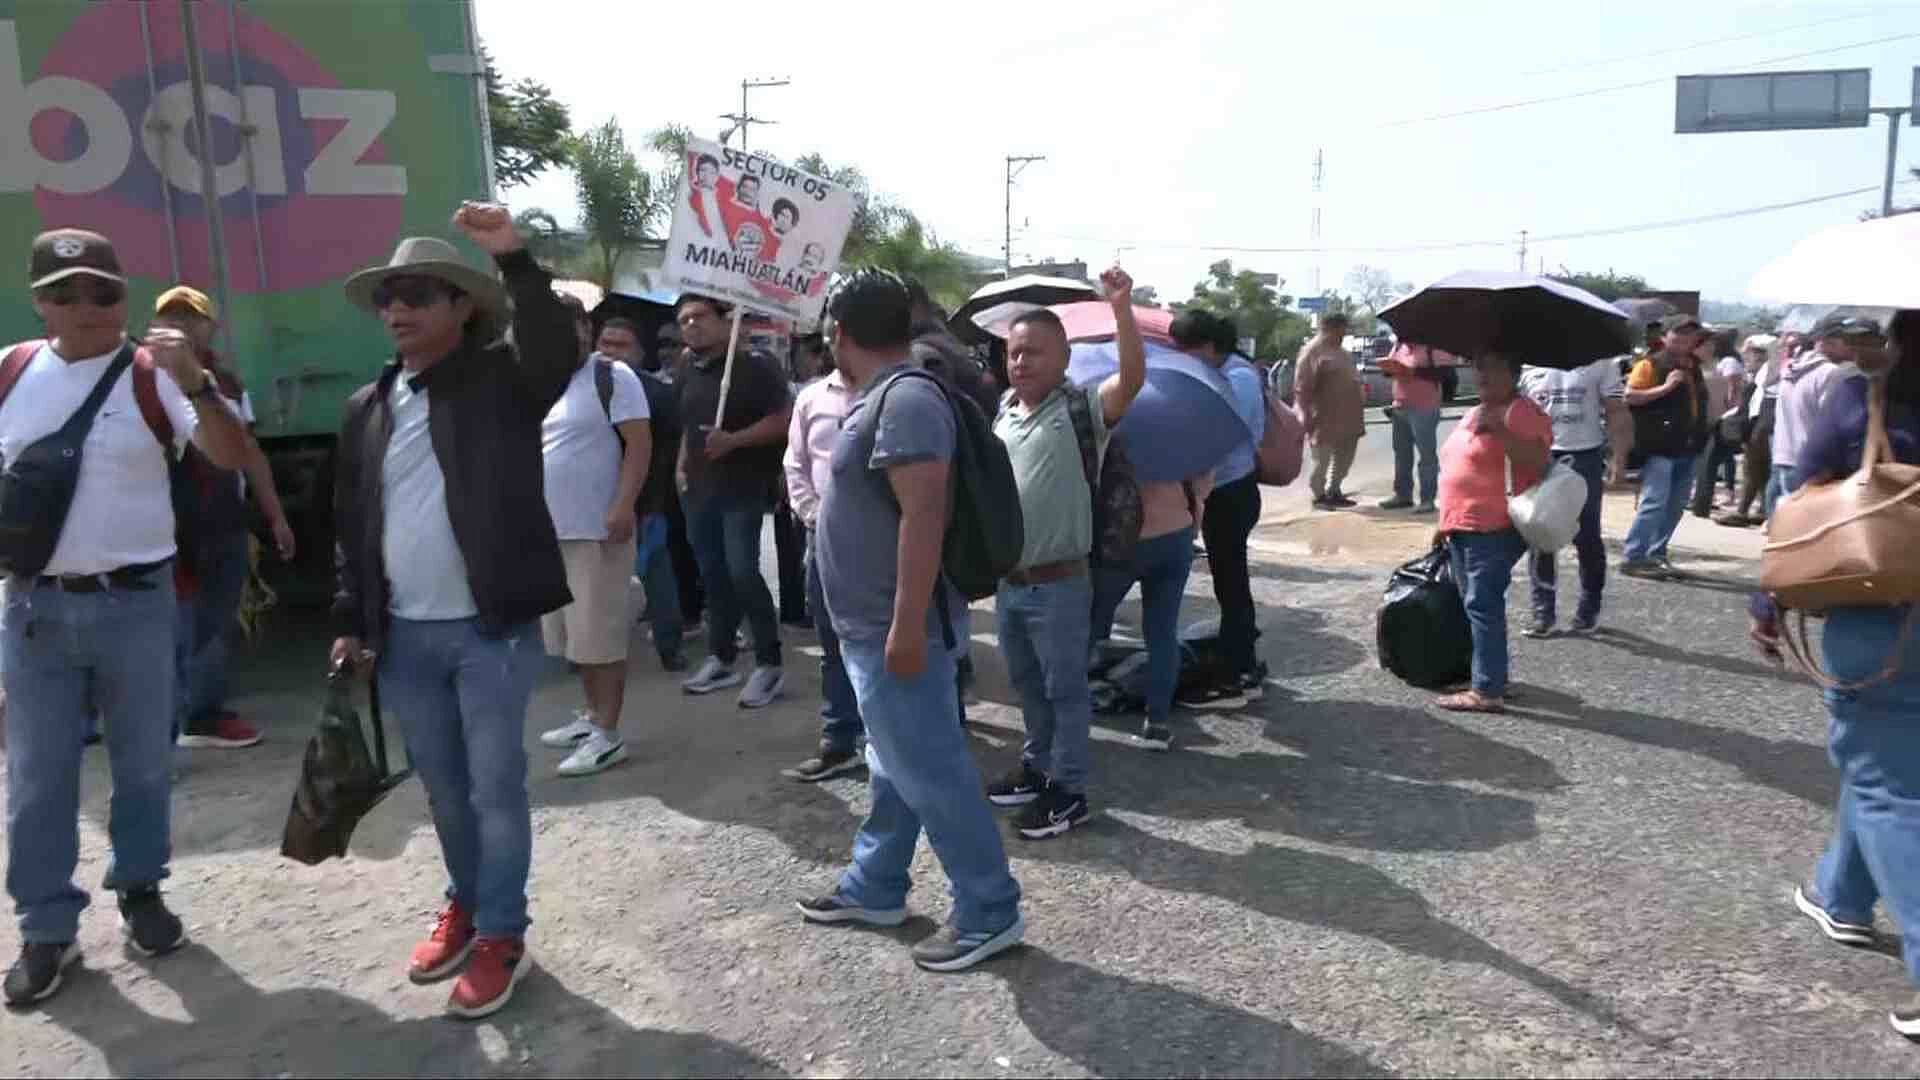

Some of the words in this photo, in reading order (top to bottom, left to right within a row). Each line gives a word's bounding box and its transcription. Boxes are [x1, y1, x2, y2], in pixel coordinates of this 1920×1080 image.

[0, 19, 407, 195] baz
[722, 147, 798, 187] SECTOR
[803, 178, 831, 201] 05
